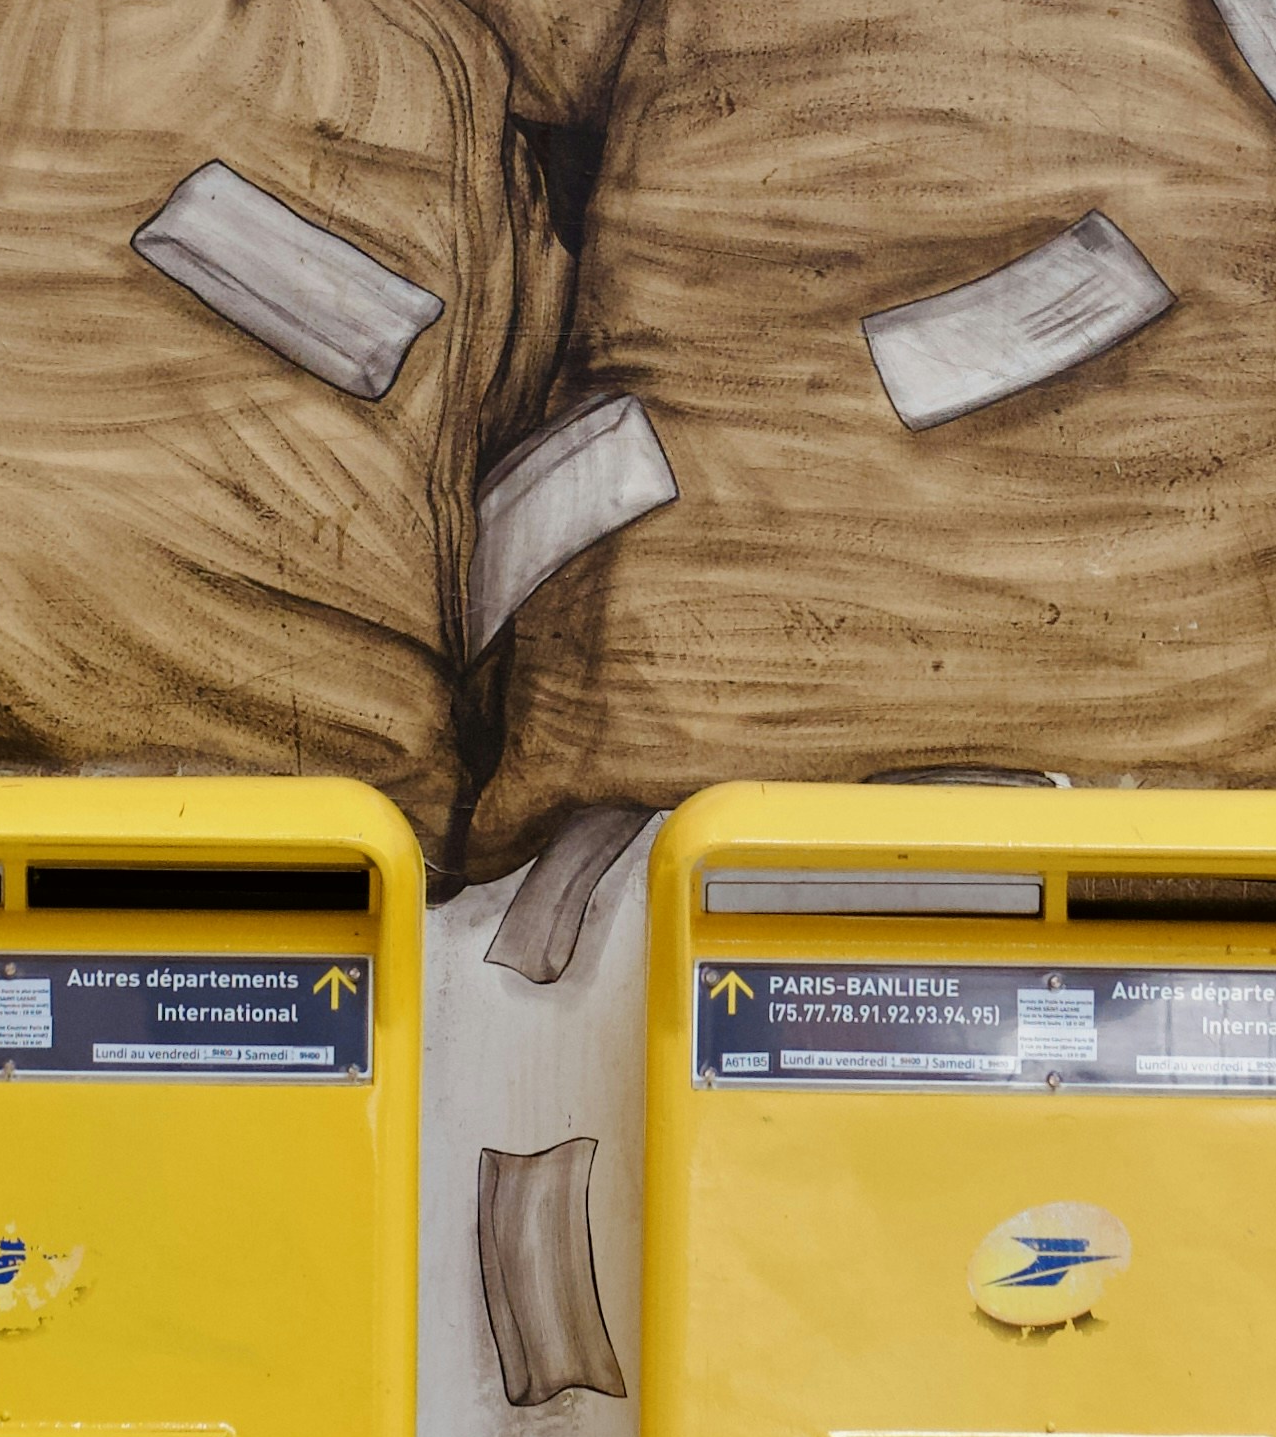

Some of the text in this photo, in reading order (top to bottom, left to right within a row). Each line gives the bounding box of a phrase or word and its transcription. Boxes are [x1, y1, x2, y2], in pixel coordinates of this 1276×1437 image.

[67, 968, 299, 991] Autres départements
[769, 975, 960, 997] PARIS-BANLIEUE
[1112, 981, 1185, 1001] Autres
[157, 1003, 298, 1023] International
[768, 1002, 1000, 1026] (75.77.78.91.92.93.94.95)
[95, 1047, 127, 1059] Lundi
[131, 1050, 145, 1059] au
[148, 1048, 200, 1060] vendredi
[245, 1049, 288, 1060] Samedi
[783, 1054, 815, 1066] Lundi
[818, 1057, 832, 1066] au
[835, 1056, 888, 1067] vendredi
[932, 1057, 976, 1070] Samedi
[1138, 1059, 1171, 1070] Lundi
[1173, 1061, 1188, 1071] au
[1191, 1060, 1244, 1072] vendredi
